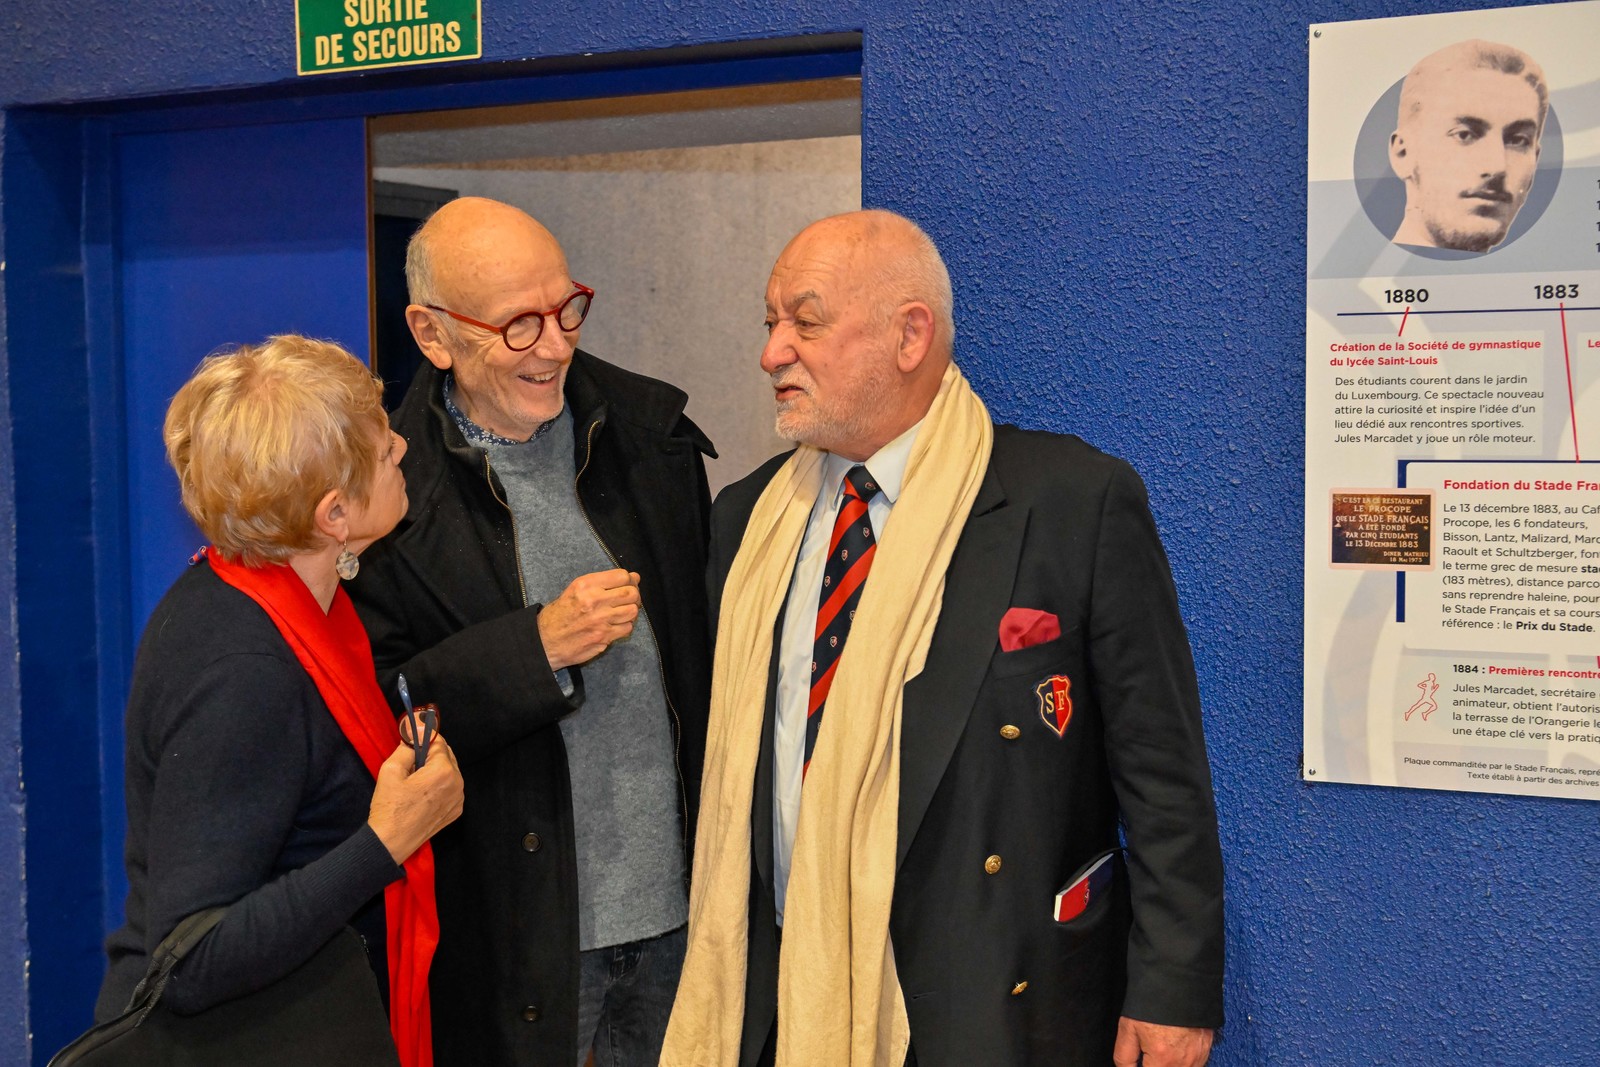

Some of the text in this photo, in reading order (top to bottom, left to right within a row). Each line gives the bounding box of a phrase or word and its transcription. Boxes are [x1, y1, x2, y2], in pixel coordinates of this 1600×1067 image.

[315, 21, 461, 66] DE SECOURS
[1384, 288, 1429, 304] 1880
[1534, 284, 1579, 300] 1883
[1330, 340, 1541, 352] Création de la Société de gymnastique
[1329, 356, 1438, 368] du lycée Saint-Louis
[1335, 375, 1528, 386] Des étudiants courent dans le jardin
[1334, 390, 1544, 402] du Luxembourg. Ce spectacle nouveau
[1334, 404, 1536, 415] attire la curiosité et inspire l'idée d'un
[1335, 419, 1524, 430] lieu dédié aux rencontres sportives.
[1334, 433, 1536, 445] Jules Marcadet y joue un rôle moteur.
[1444, 479, 1600, 491] Fondation du Stade Fra
[1382, 497, 1424, 505] RESTAURANT
[1354, 504, 1412, 514] LE PROCOPE
[1443, 503, 1457, 513] Le
[1459, 503, 1471, 513] 13
[1473, 503, 1530, 514] décembre
[1533, 504, 1561, 515] 1883,
[1564, 506, 1578, 514] au
[1335, 515, 1348, 524] QUE
[1358, 514, 1384, 523] STADE
[1386, 514, 1429, 525] FRANÇAIS
[1443, 517, 1588, 530] Procope, les 6 fondateurs,
[1345, 531, 1359, 539] PAR
[1360, 532, 1378, 540] CINQ
[1443, 532, 1481, 543] Bisson,
[1484, 533, 1518, 544] Lantz,
[1521, 533, 1571, 545] Malizard,
[1399, 540, 1419, 548] 1883
[1443, 546, 1478, 557] Raoult
[1481, 548, 1493, 557] et
[1495, 547, 1577, 560] Schultzberger,
[1443, 560, 1600, 574] le terme grec de mesure sta
[1442, 575, 1465, 586] (183
[1468, 576, 1514, 587] mètres),
[1516, 577, 1564, 588] distance
[1442, 591, 1467, 600] sans
[1469, 591, 1525, 602] reprendre
[1527, 592, 1570, 603] haleine,
[1442, 604, 1452, 614] le
[1454, 604, 1487, 615] Stade
[1489, 605, 1536, 617] Français
[1539, 608, 1551, 617] et
[1554, 609, 1566, 617] sa
[1442, 618, 1494, 629] référence
[1503, 620, 1513, 630] le
[1516, 621, 1538, 631] Prix
[1541, 621, 1556, 631] du
[1559, 622, 1596, 633] Stade.
[1453, 664, 1479, 674] 1884
[1488, 665, 1545, 677] Premières
[1452, 683, 1481, 694] Jules
[1483, 685, 1538, 697] Marcadet,
[1540, 688, 1596, 699] secrétaire
[1452, 698, 1510, 710] animateur,
[1512, 700, 1553, 712] obtient
[1452, 711, 1462, 721] la
[1465, 713, 1509, 724] terrasse
[1511, 715, 1526, 725] de
[1528, 715, 1591, 729] l'Orangerie
[1452, 728, 1473, 736] une
[1475, 727, 1507, 739] étape
[1509, 729, 1526, 739] clé
[1528, 732, 1552, 741] vers
[1555, 731, 1565, 741] la
[1404, 757, 1431, 766] Plaque
[1432, 760, 1488, 769] commanditée
[1489, 763, 1503, 771] par
[1504, 763, 1512, 771] le
[1514, 763, 1538, 773] Stade
[1540, 765, 1577, 775] Français,
[1467, 771, 1600, 787] Texte établi à partir des archives
